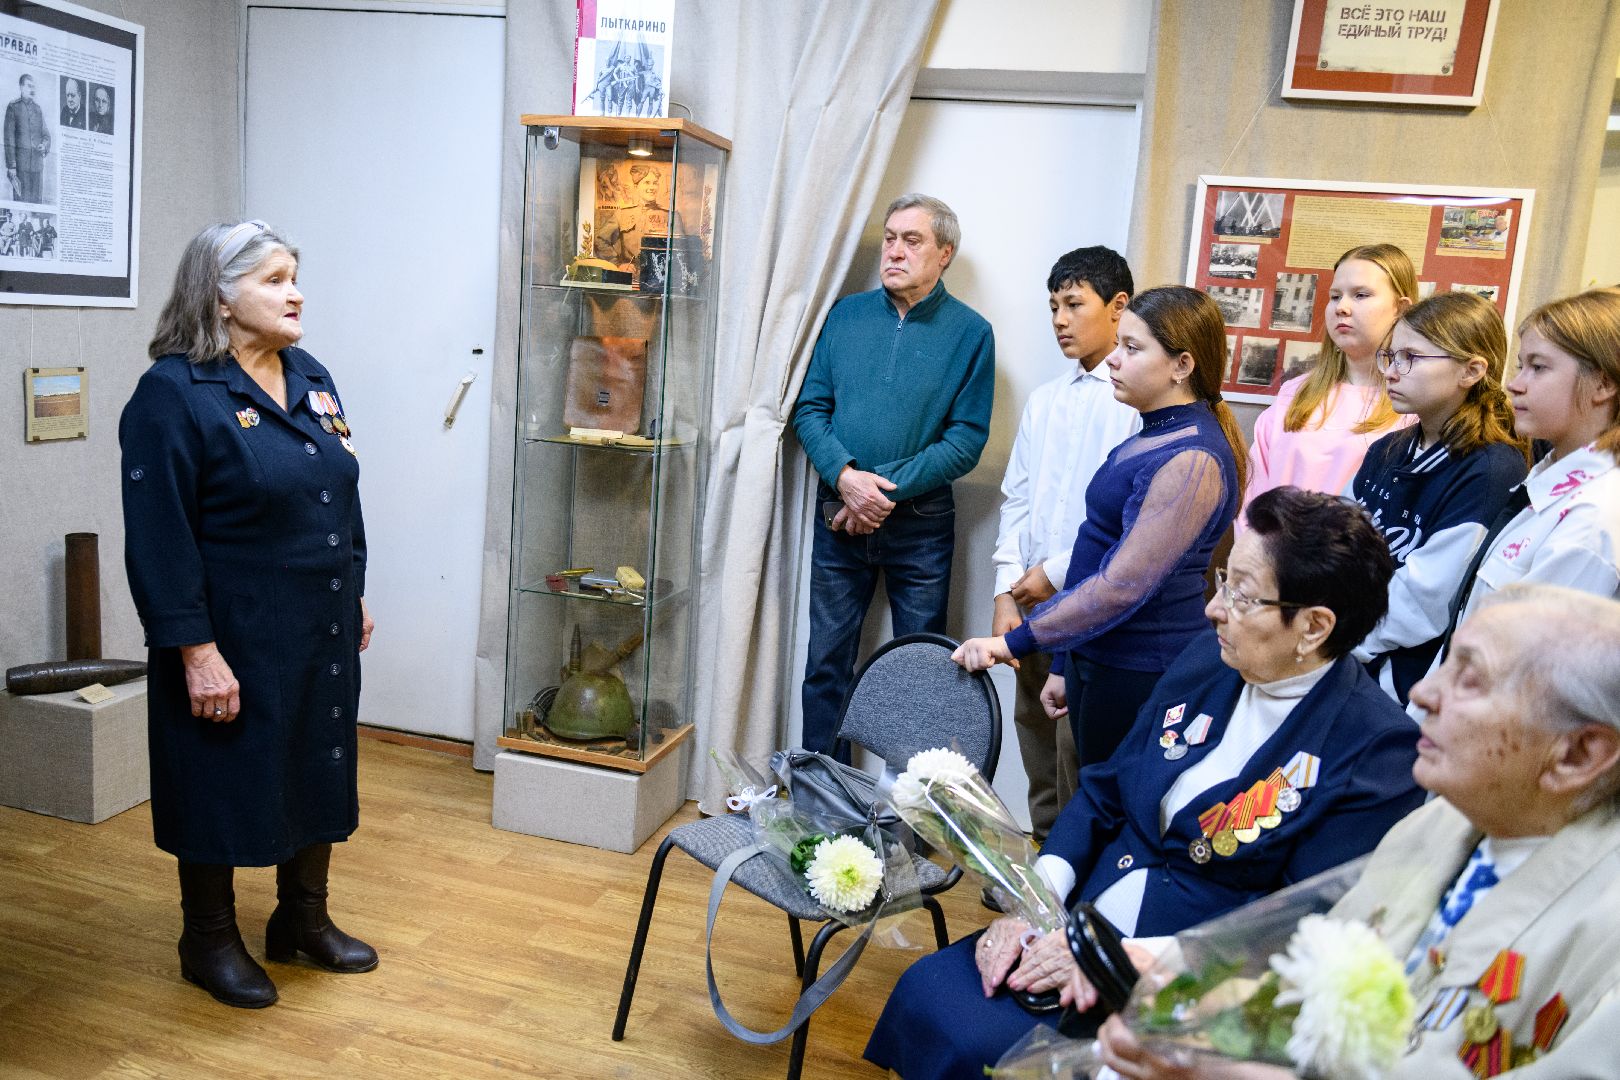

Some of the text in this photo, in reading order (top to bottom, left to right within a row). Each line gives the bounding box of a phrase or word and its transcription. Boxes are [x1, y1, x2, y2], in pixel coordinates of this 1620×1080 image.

[1340, 4, 1446, 23] ВСЁ ЭТО НАШ
[601, 16, 666, 34] ЛЫТКАРИНО
[1338, 22, 1448, 42] ЕДИНЫЙ ТРУД!
